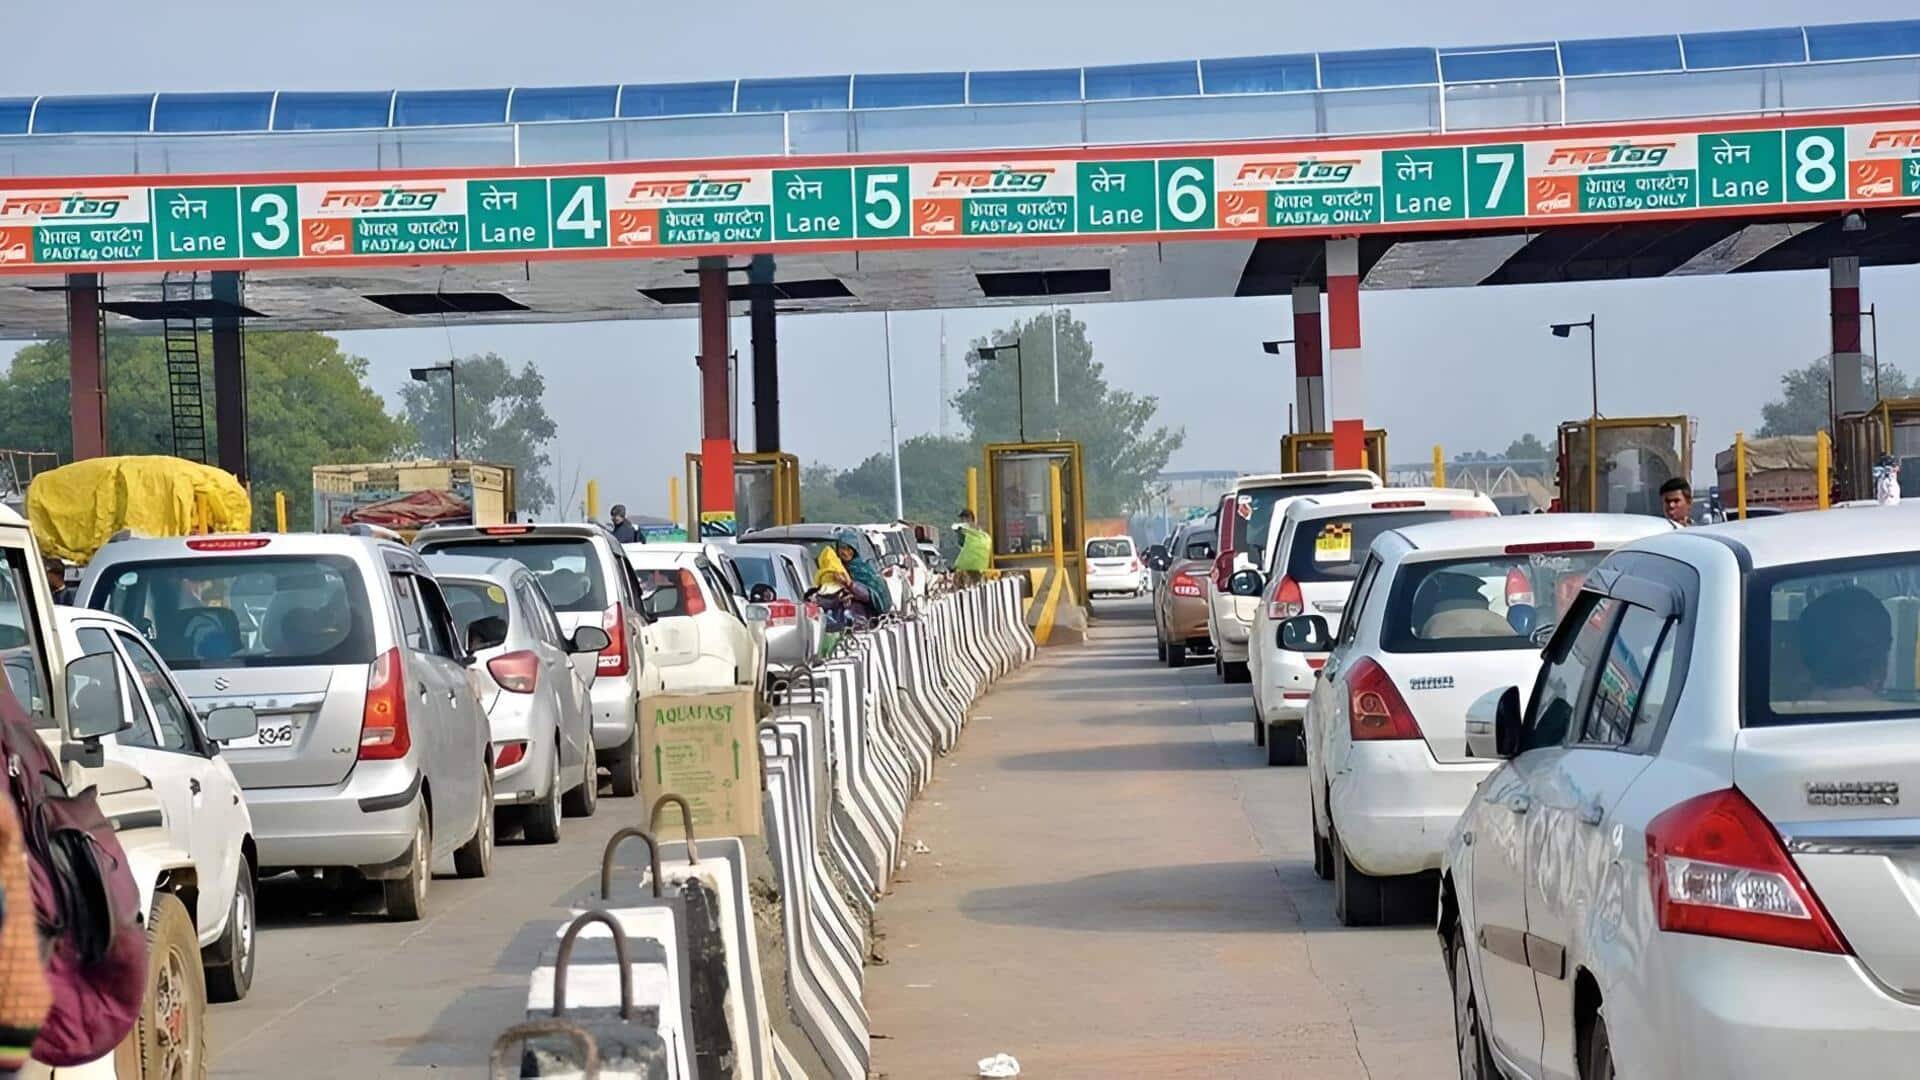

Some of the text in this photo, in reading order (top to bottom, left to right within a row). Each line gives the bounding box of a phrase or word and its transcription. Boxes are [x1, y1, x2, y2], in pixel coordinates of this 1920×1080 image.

[1712, 139, 1752, 166] लेन
[1396, 154, 1433, 181] लेन
[1795, 135, 1837, 194] 8
[785, 174, 823, 201] लेन
[1090, 167, 1126, 193] लेन
[1475, 153, 1515, 209] 7
[1712, 177, 1769, 199] Lane
[480, 185, 517, 211] लेन
[864, 173, 902, 229] 5
[1166, 166, 1207, 223] 6
[1396, 194, 1452, 214] Lane
[1646, 193, 1687, 208] ONLY
[170, 193, 208, 219] लेन
[556, 184, 602, 240] 4
[1090, 205, 1144, 226] Lane
[1333, 209, 1373, 222] ONLY
[250, 193, 289, 251] 3
[482, 223, 536, 243] Lane
[786, 212, 841, 233] Lane
[1026, 218, 1065, 232] ONLY
[170, 231, 226, 251] Lane
[418, 238, 458, 251] ONLY
[724, 227, 762, 241] ONLY
[101, 245, 142, 258] ONLY
[655, 704, 732, 726] AQUAFAST
